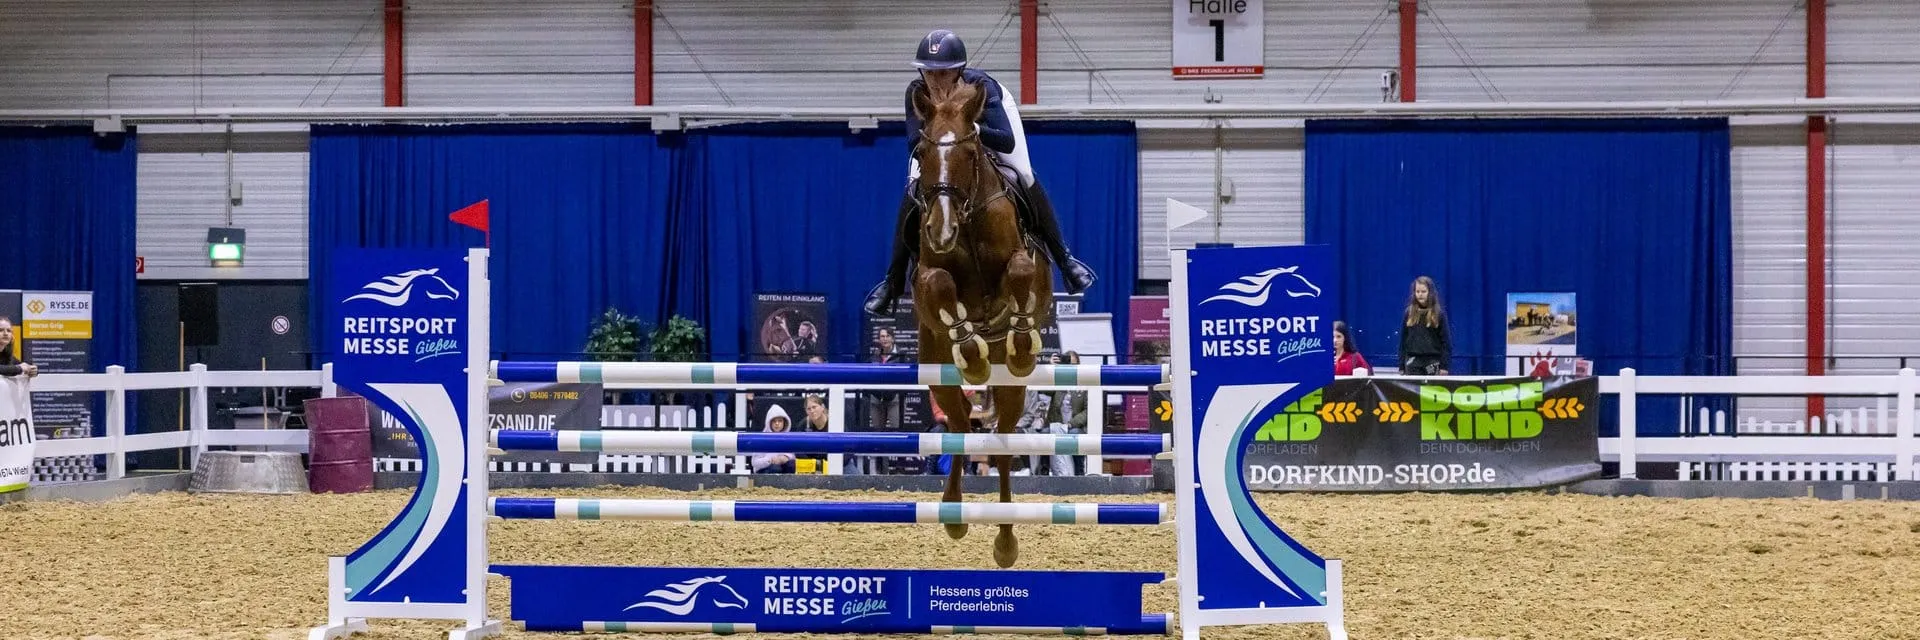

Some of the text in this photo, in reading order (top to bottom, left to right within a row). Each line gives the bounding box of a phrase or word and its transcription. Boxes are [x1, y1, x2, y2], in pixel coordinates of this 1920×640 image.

[1189, 0, 1247, 13] Halle
[1209, 19, 1224, 62] 1
[50, 301, 89, 310] RYSSE.DE
[758, 294, 782, 302] REITEN
[792, 295, 825, 303] EINKLANG
[344, 317, 457, 334] REITSPORT
[1201, 316, 1320, 336] REITSPORT
[344, 338, 457, 357] MESSE Gießen
[1202, 337, 1321, 357] MESSE Gießen
[1420, 382, 1543, 411] DORF
[1421, 411, 1544, 441] KIND
[1420, 440, 1540, 454] DEIN DORFLADEN
[1249, 463, 1496, 485] DORFKIND-SHOP.de
[764, 575, 886, 594] REITSPORT
[930, 585, 1029, 600] Hessens größtes
[764, 598, 887, 617] MESSE Gießen
[930, 600, 1015, 613] Pferdeerlebnis
